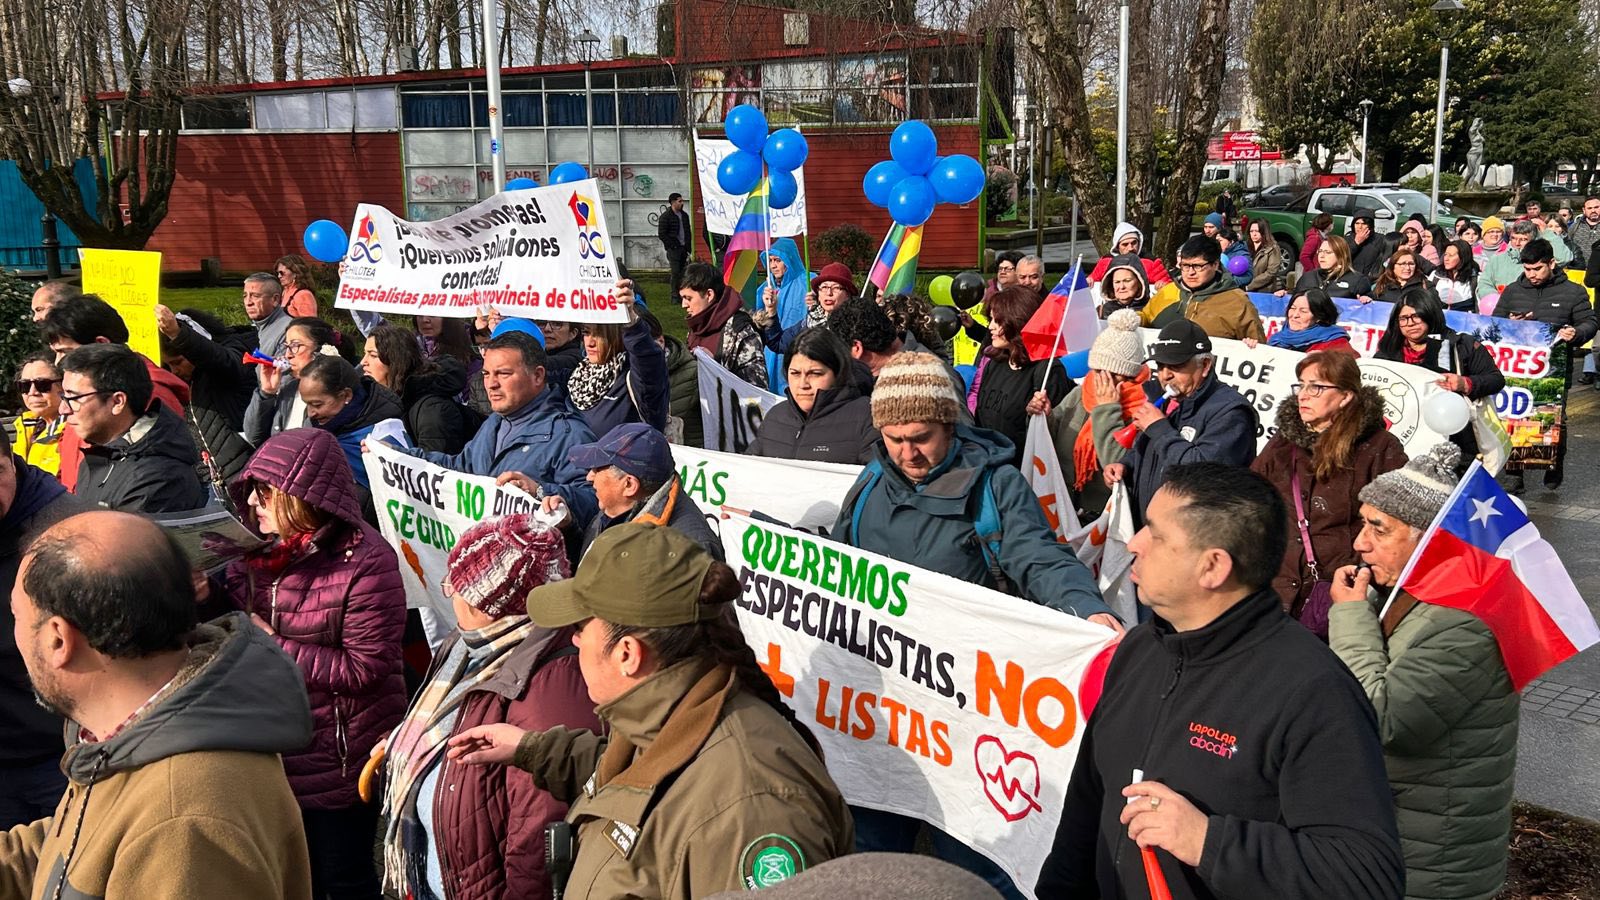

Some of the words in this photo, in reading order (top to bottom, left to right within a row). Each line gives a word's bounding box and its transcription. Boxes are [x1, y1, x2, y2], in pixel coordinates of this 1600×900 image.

[1225, 150, 1260, 160] PLAZA
[399, 243, 482, 269] ¡Queremos
[340, 283, 419, 304] Especialistas
[418, 291, 447, 309] para
[545, 288, 566, 309] de
[570, 288, 618, 311] Chiloé
[378, 455, 449, 511] CHILOÉ
[456, 479, 485, 521] NO
[742, 524, 910, 617] QUEREMOS
[735, 565, 967, 709] ESPECIALISTAS,
[975, 650, 1077, 749] NO
[815, 678, 953, 767] LISTAS
[1189, 735, 1232, 760] abcdin
